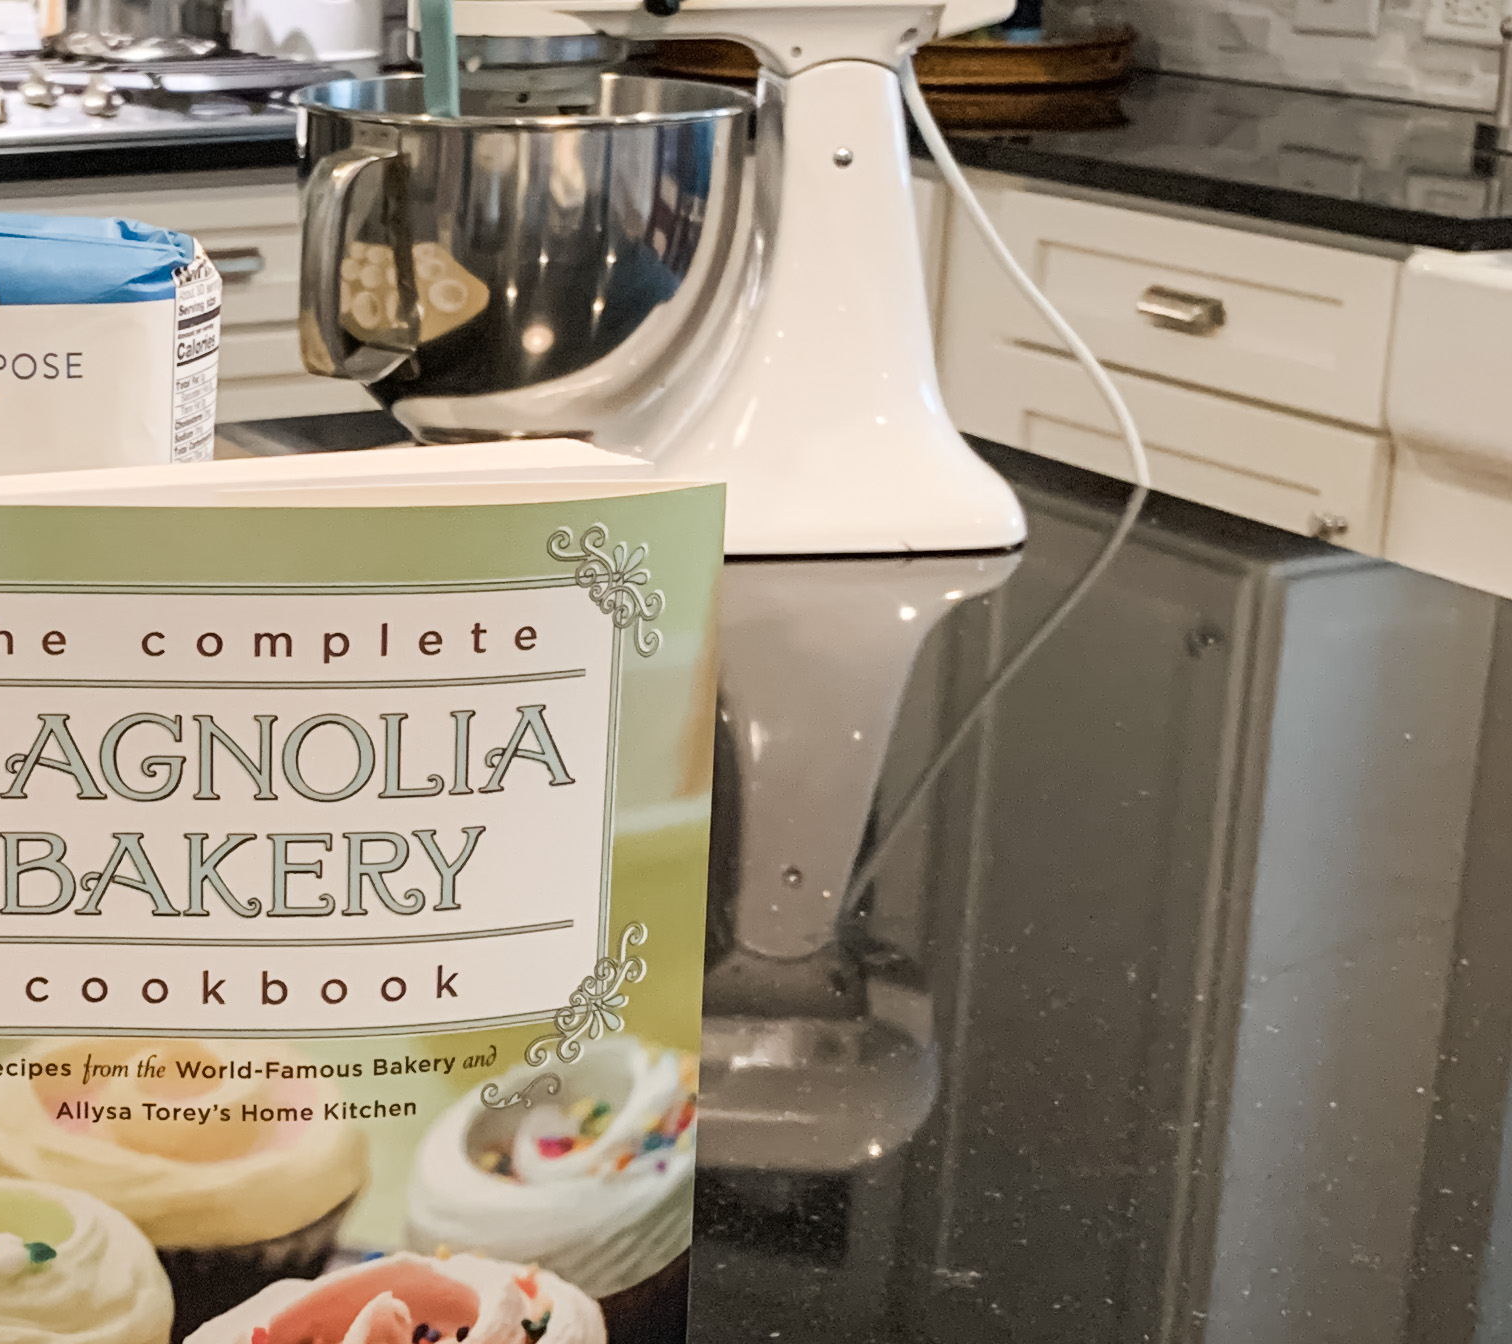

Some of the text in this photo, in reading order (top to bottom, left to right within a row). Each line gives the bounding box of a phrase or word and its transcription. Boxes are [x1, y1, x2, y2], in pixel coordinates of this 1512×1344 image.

[177, 334, 216, 360] Calories
[140, 619, 541, 665] complete
[24, 964, 462, 1007] cookbook
[81, 1053, 130, 1086] from
[136, 1053, 167, 1080] the
[175, 1059, 363, 1080] World-Famous
[373, 1053, 456, 1077] Bakery
[462, 1045, 498, 1070] and
[56, 1100, 132, 1123] Allysa
[241, 1102, 314, 1122] Home
[324, 1098, 418, 1120] Kitchen
